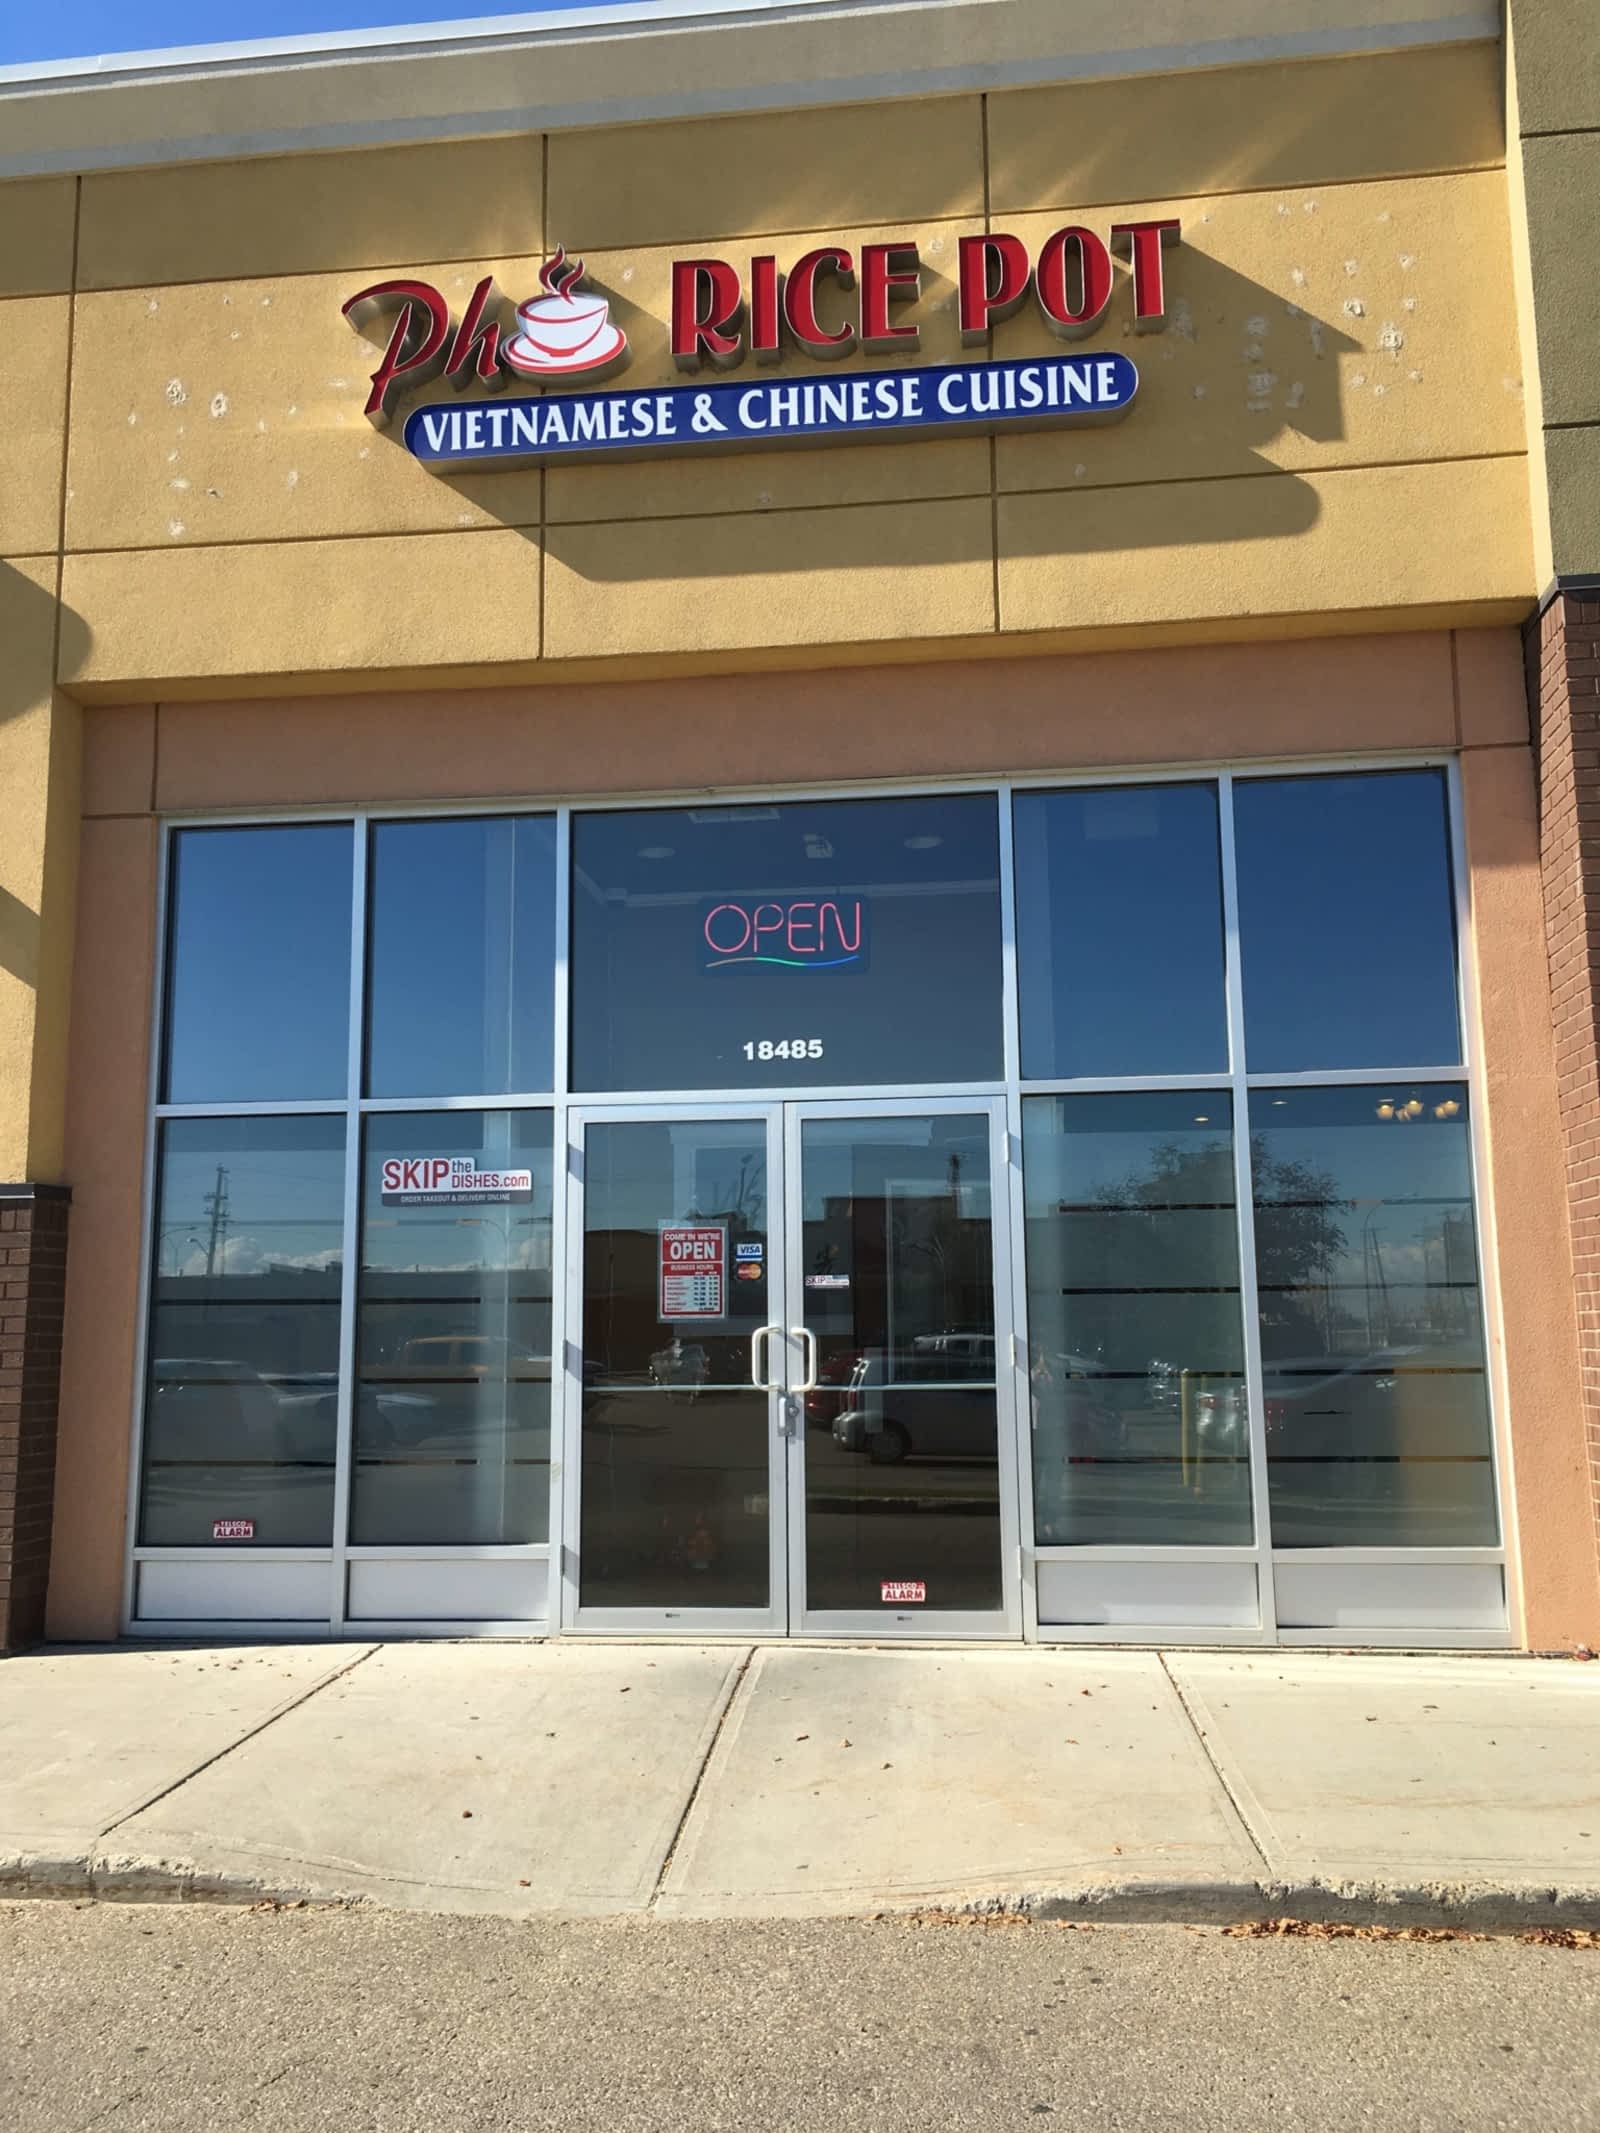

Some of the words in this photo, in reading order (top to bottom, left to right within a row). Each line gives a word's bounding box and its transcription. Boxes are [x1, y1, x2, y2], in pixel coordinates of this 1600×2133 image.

[671, 243, 920, 355] RICE
[958, 219, 1181, 332] POT
[421, 396, 678, 453] VIETNAMESE
[690, 391, 725, 432] &
[737, 376, 923, 431] CHINESE
[936, 361, 1121, 412] CUISINE
[704, 901, 861, 953] OPEN
[743, 1039, 824, 1060] 18485
[383, 1160, 450, 1191] SKIP
[452, 1160, 472, 1173] the
[452, 1174, 529, 1189] DISHES.com
[664, 1232, 686, 1240] COME
[688, 1232, 696, 1240] IN
[670, 1241, 716, 1260] OPEN
[740, 1246, 760, 1254] VISA
[216, 1528, 251, 1537] ALARM
[885, 1590, 923, 1599] ALARM
